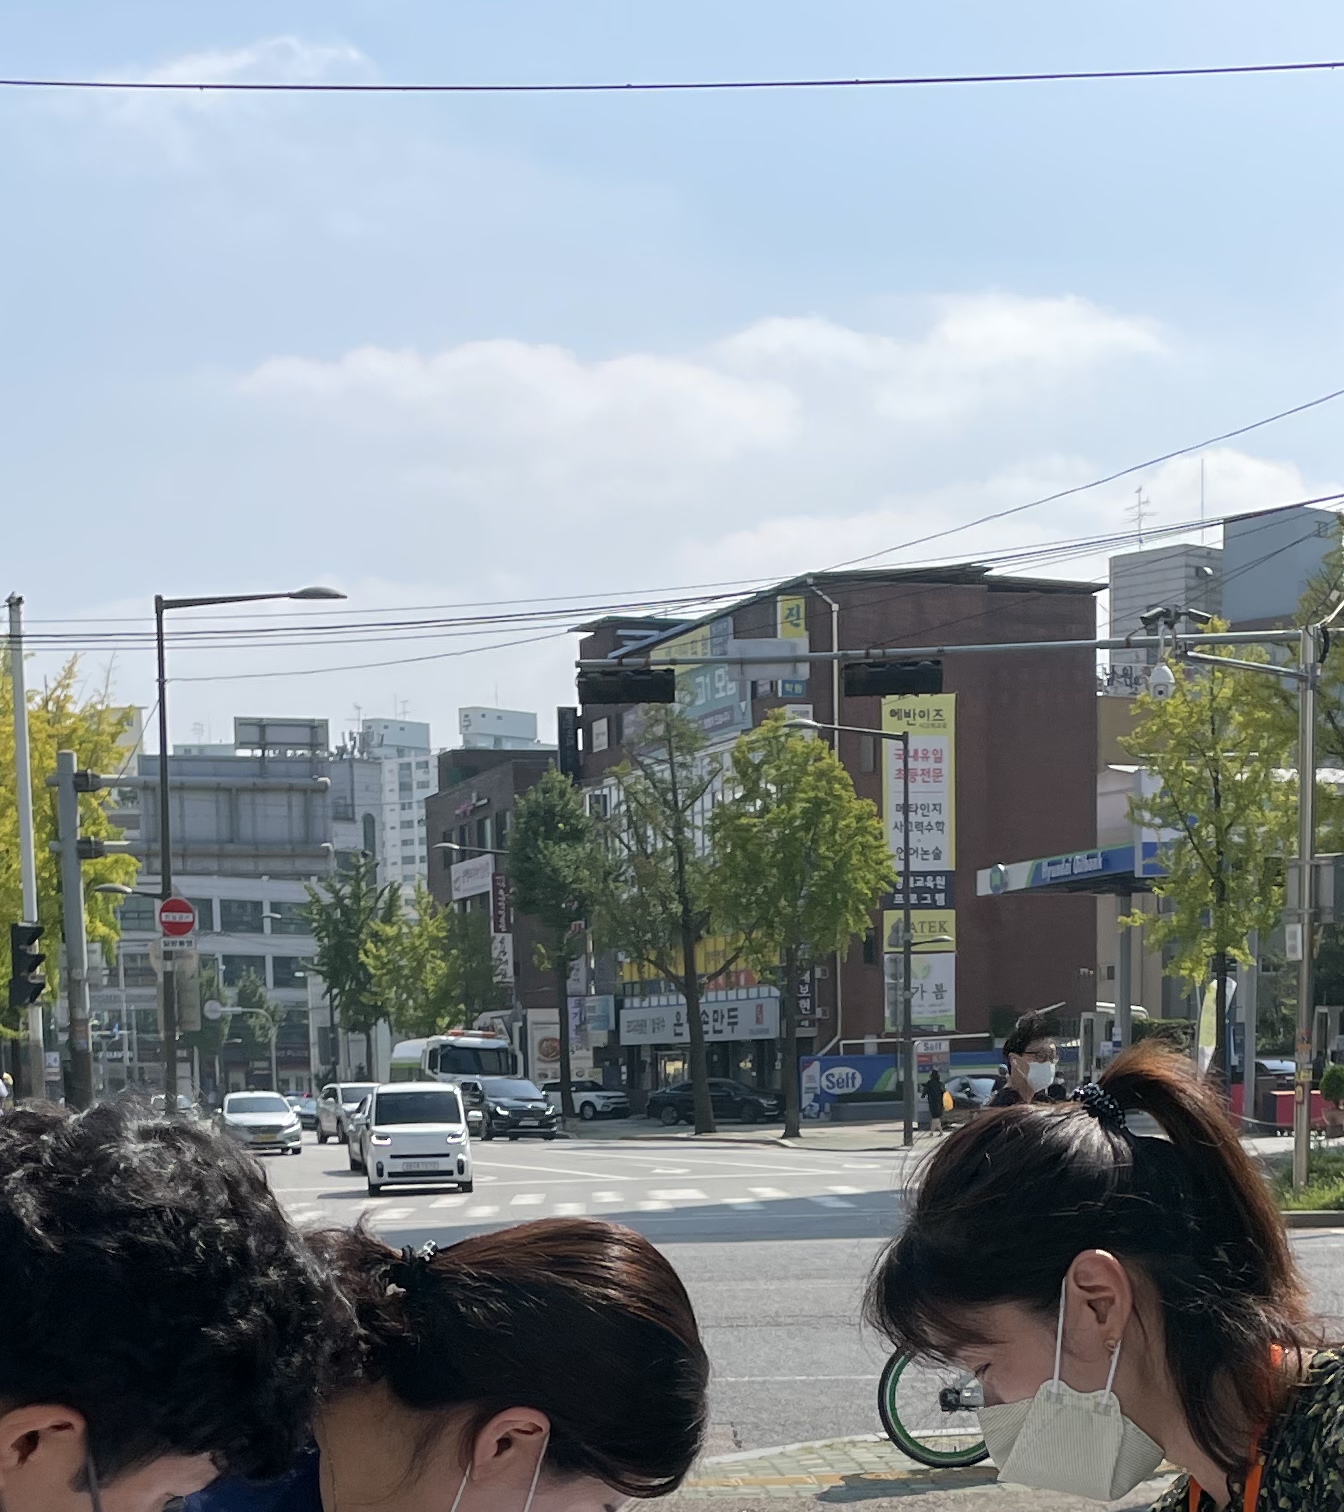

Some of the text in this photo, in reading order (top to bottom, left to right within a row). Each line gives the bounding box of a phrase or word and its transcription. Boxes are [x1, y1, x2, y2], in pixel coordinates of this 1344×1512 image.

[889, 708, 946, 726] 에반이즈
[894, 748, 944, 763] 국내유일
[894, 768, 944, 784] 초등전문
[672, 1007, 739, 1037] 온손만두
[824, 1071, 856, 1090] Self
